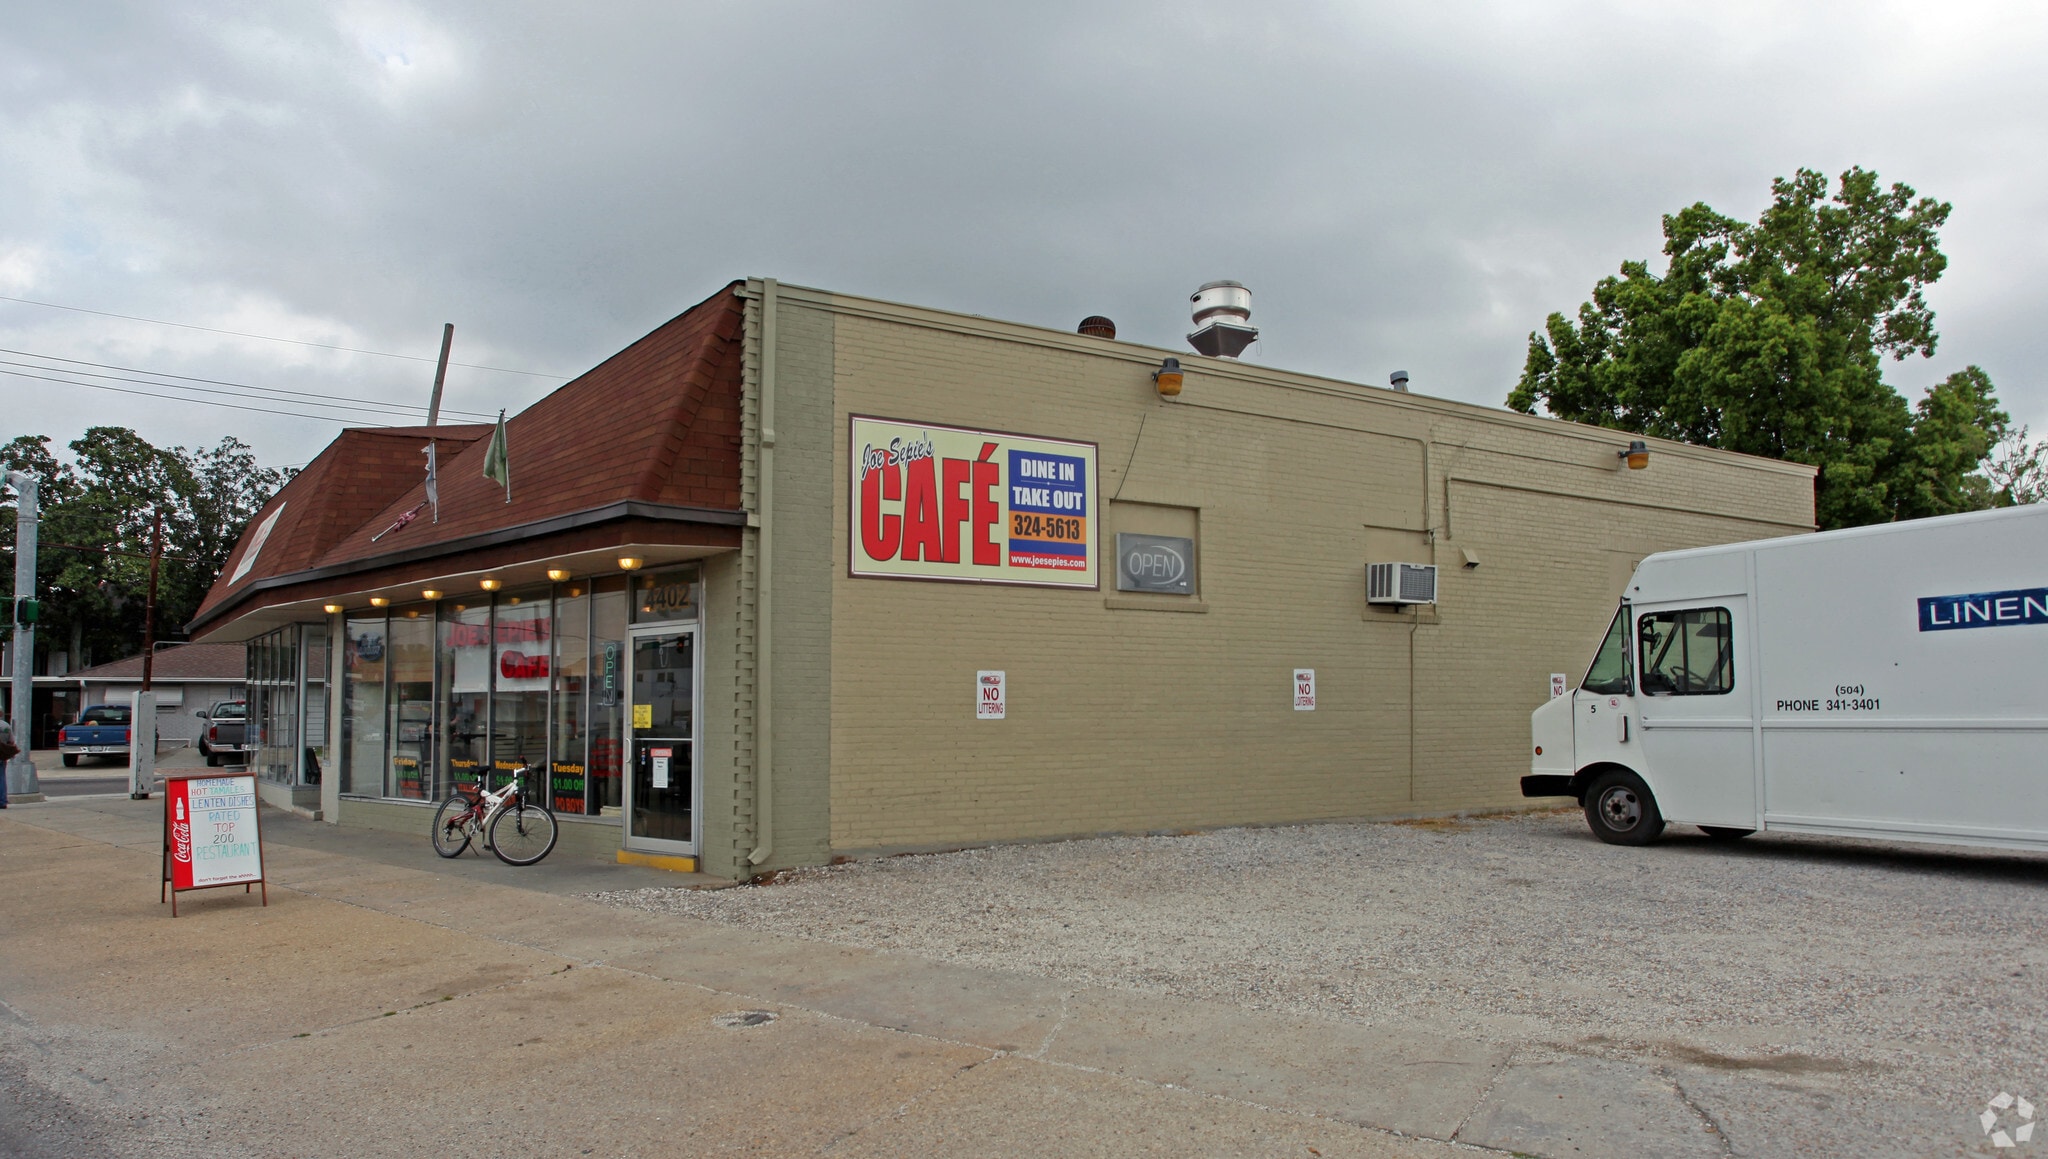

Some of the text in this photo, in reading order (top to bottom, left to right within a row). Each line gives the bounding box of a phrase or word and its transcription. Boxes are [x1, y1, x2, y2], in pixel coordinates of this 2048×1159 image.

[861, 430, 934, 480] Joe Sepie's
[1020, 458, 1075, 482] DINE IN
[861, 442, 1000, 566] CAFÉ
[1012, 486, 1083, 510] TAKE OUT
[1014, 514, 1080, 540] 324-5613
[1011, 555, 1086, 568] www.joesepies.com
[1129, 552, 1175, 577] OPEN
[645, 584, 690, 608] 4402
[1930, 595, 2048, 625] LINEN
[445, 620, 480, 648] JOE
[605, 646, 615, 702] OPEN
[983, 687, 999, 701] NO
[1298, 683, 1310, 695] NO
[1554, 685, 1562, 696] NO
[1835, 684, 1864, 696] (504)
[1591, 704, 1596, 713] 5
[1777, 699, 1880, 711] PHONE 341-3401
[393, 757, 417, 767] Friday
[552, 762, 584, 775] Tuesday
[191, 785, 246, 796] HOT TAMALES
[553, 778, 584, 791] $1.00 Off
[192, 796, 255, 809] LENTEN DISHES
[555, 797, 585, 813] PO BOYS
[208, 810, 241, 821] RATED
[213, 822, 236, 833] TOP
[173, 821, 191, 863] Coca-Cola
[213, 833, 235, 845] 200
[196, 842, 257, 860] RESTAURANT
